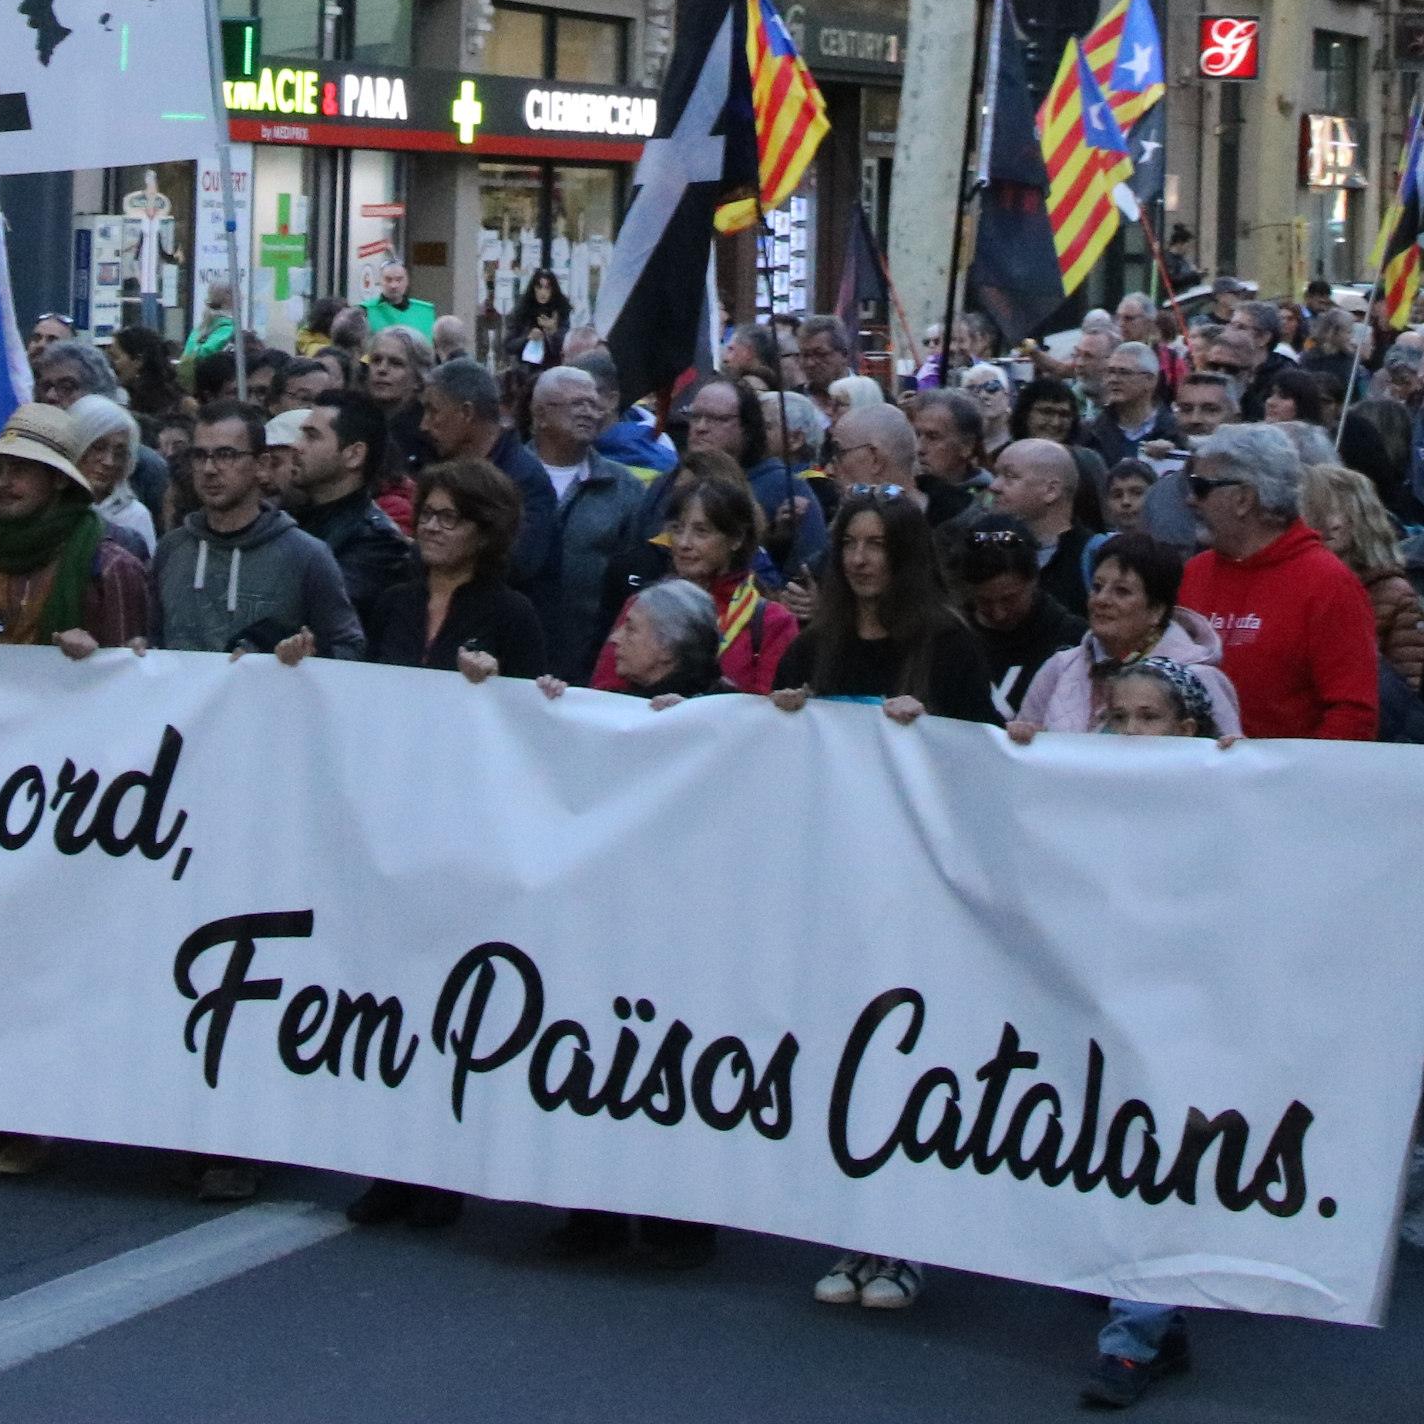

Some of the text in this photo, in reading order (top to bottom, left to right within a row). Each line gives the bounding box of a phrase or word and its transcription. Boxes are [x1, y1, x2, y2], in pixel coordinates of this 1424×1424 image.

[343, 74, 408, 120] PARA
[524, 87, 657, 137] CLEMENCEAU
[174, 909, 1337, 1219] Fem Països Catalans.
